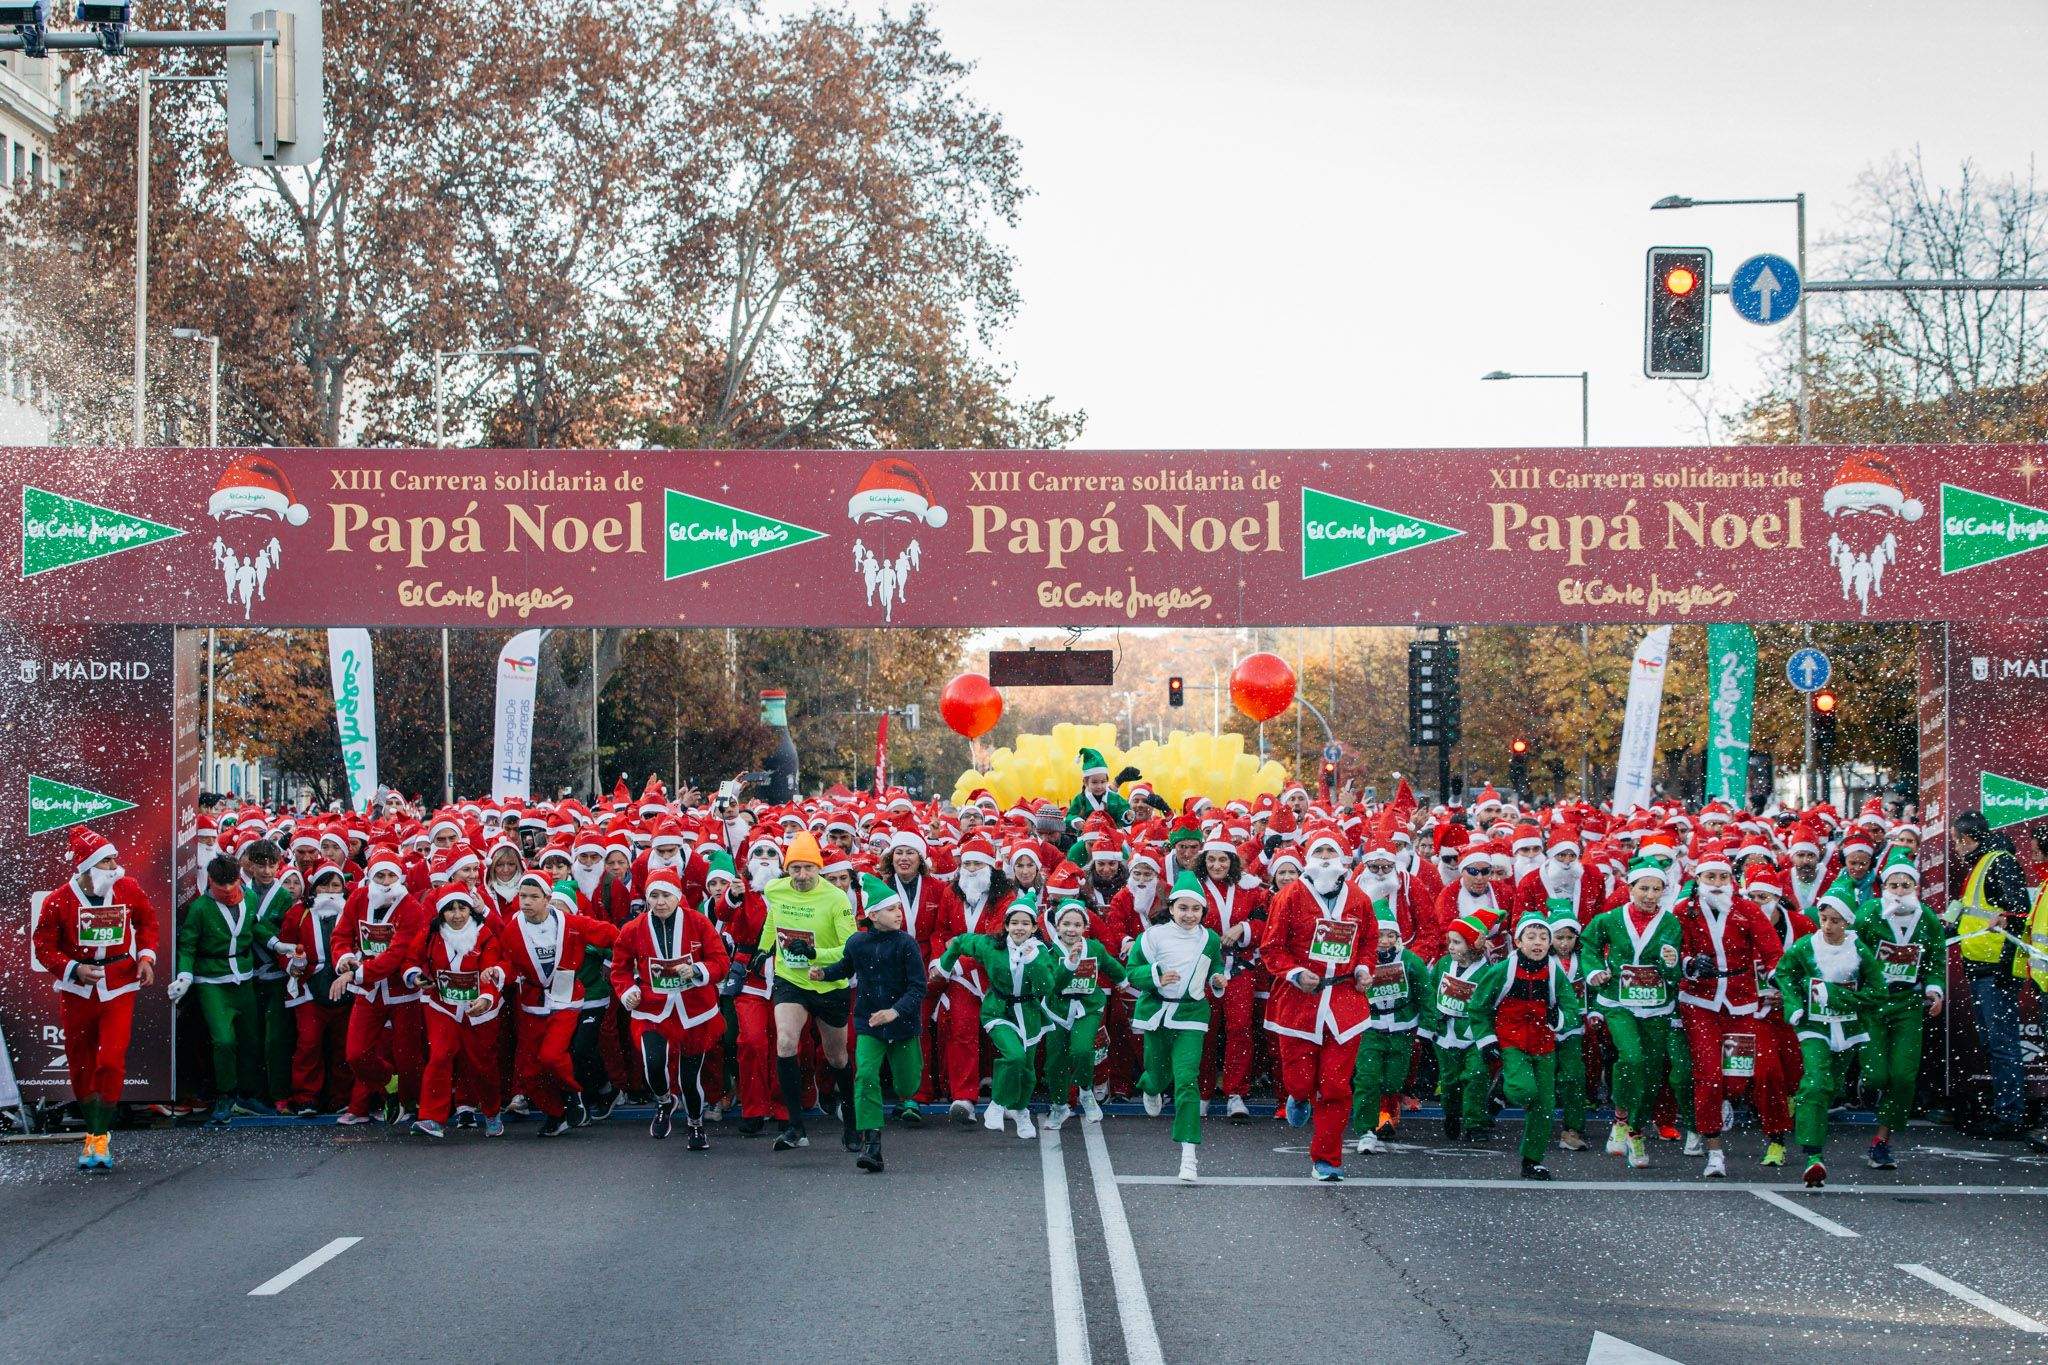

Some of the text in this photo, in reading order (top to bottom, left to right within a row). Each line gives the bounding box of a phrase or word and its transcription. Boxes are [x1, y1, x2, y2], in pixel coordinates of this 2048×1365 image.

[330, 469, 645, 492] XIII Carrera solidaria de
[969, 468, 1282, 492] XIII Carrera solidaria de
[1489, 466, 1803, 490] XIII Carrera solidaria de
[326, 500, 647, 568] Papá Noel
[669, 519, 788, 548] El Corte Inglés
[966, 500, 1285, 569] Papá Noel
[1307, 516, 1426, 545] El Corte Inglés
[1486, 497, 1806, 566] Papá Noel
[398, 576, 574, 618] El Corte Inglés
[1037, 576, 1212, 618] El Corte Inglés
[1557, 573, 1736, 615] El Corte Inglés
[52, 661, 150, 680] MADRID
[92, 927, 114, 940] 799
[1320, 942, 1347, 957] 6424
[446, 988, 470, 1000] 8211
[1372, 982, 1400, 997] 2888
[1628, 987, 1658, 999] 5303
